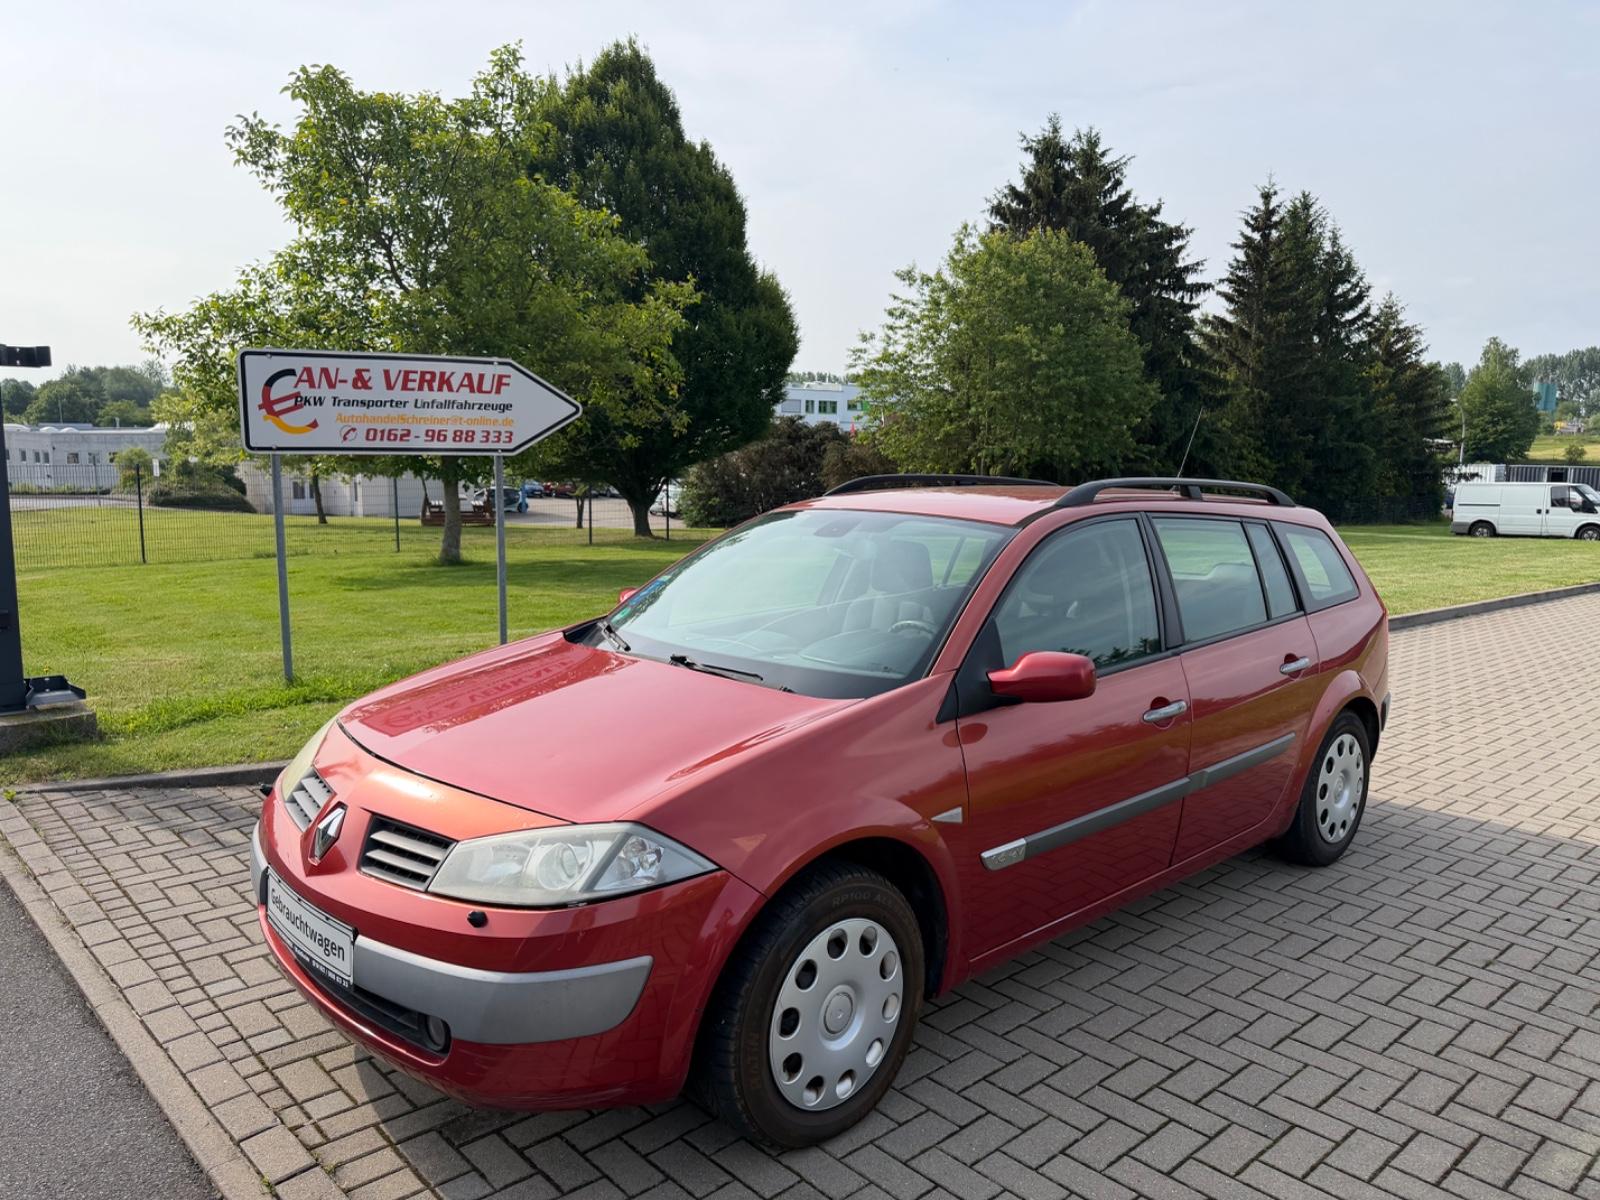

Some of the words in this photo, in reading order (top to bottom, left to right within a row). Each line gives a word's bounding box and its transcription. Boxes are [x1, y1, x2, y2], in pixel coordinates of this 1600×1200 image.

[383, 369, 511, 395] VERKAUF
[294, 396, 326, 408] PKW
[331, 396, 409, 410] Transporter
[414, 399, 513, 413] Unfallfahrzeuge
[365, 428, 412, 442] 0162
[424, 429, 448, 443] 96
[452, 429, 476, 443] 88
[480, 430, 513, 443] 333
[271, 888, 345, 962] Gebrauchtwagen
